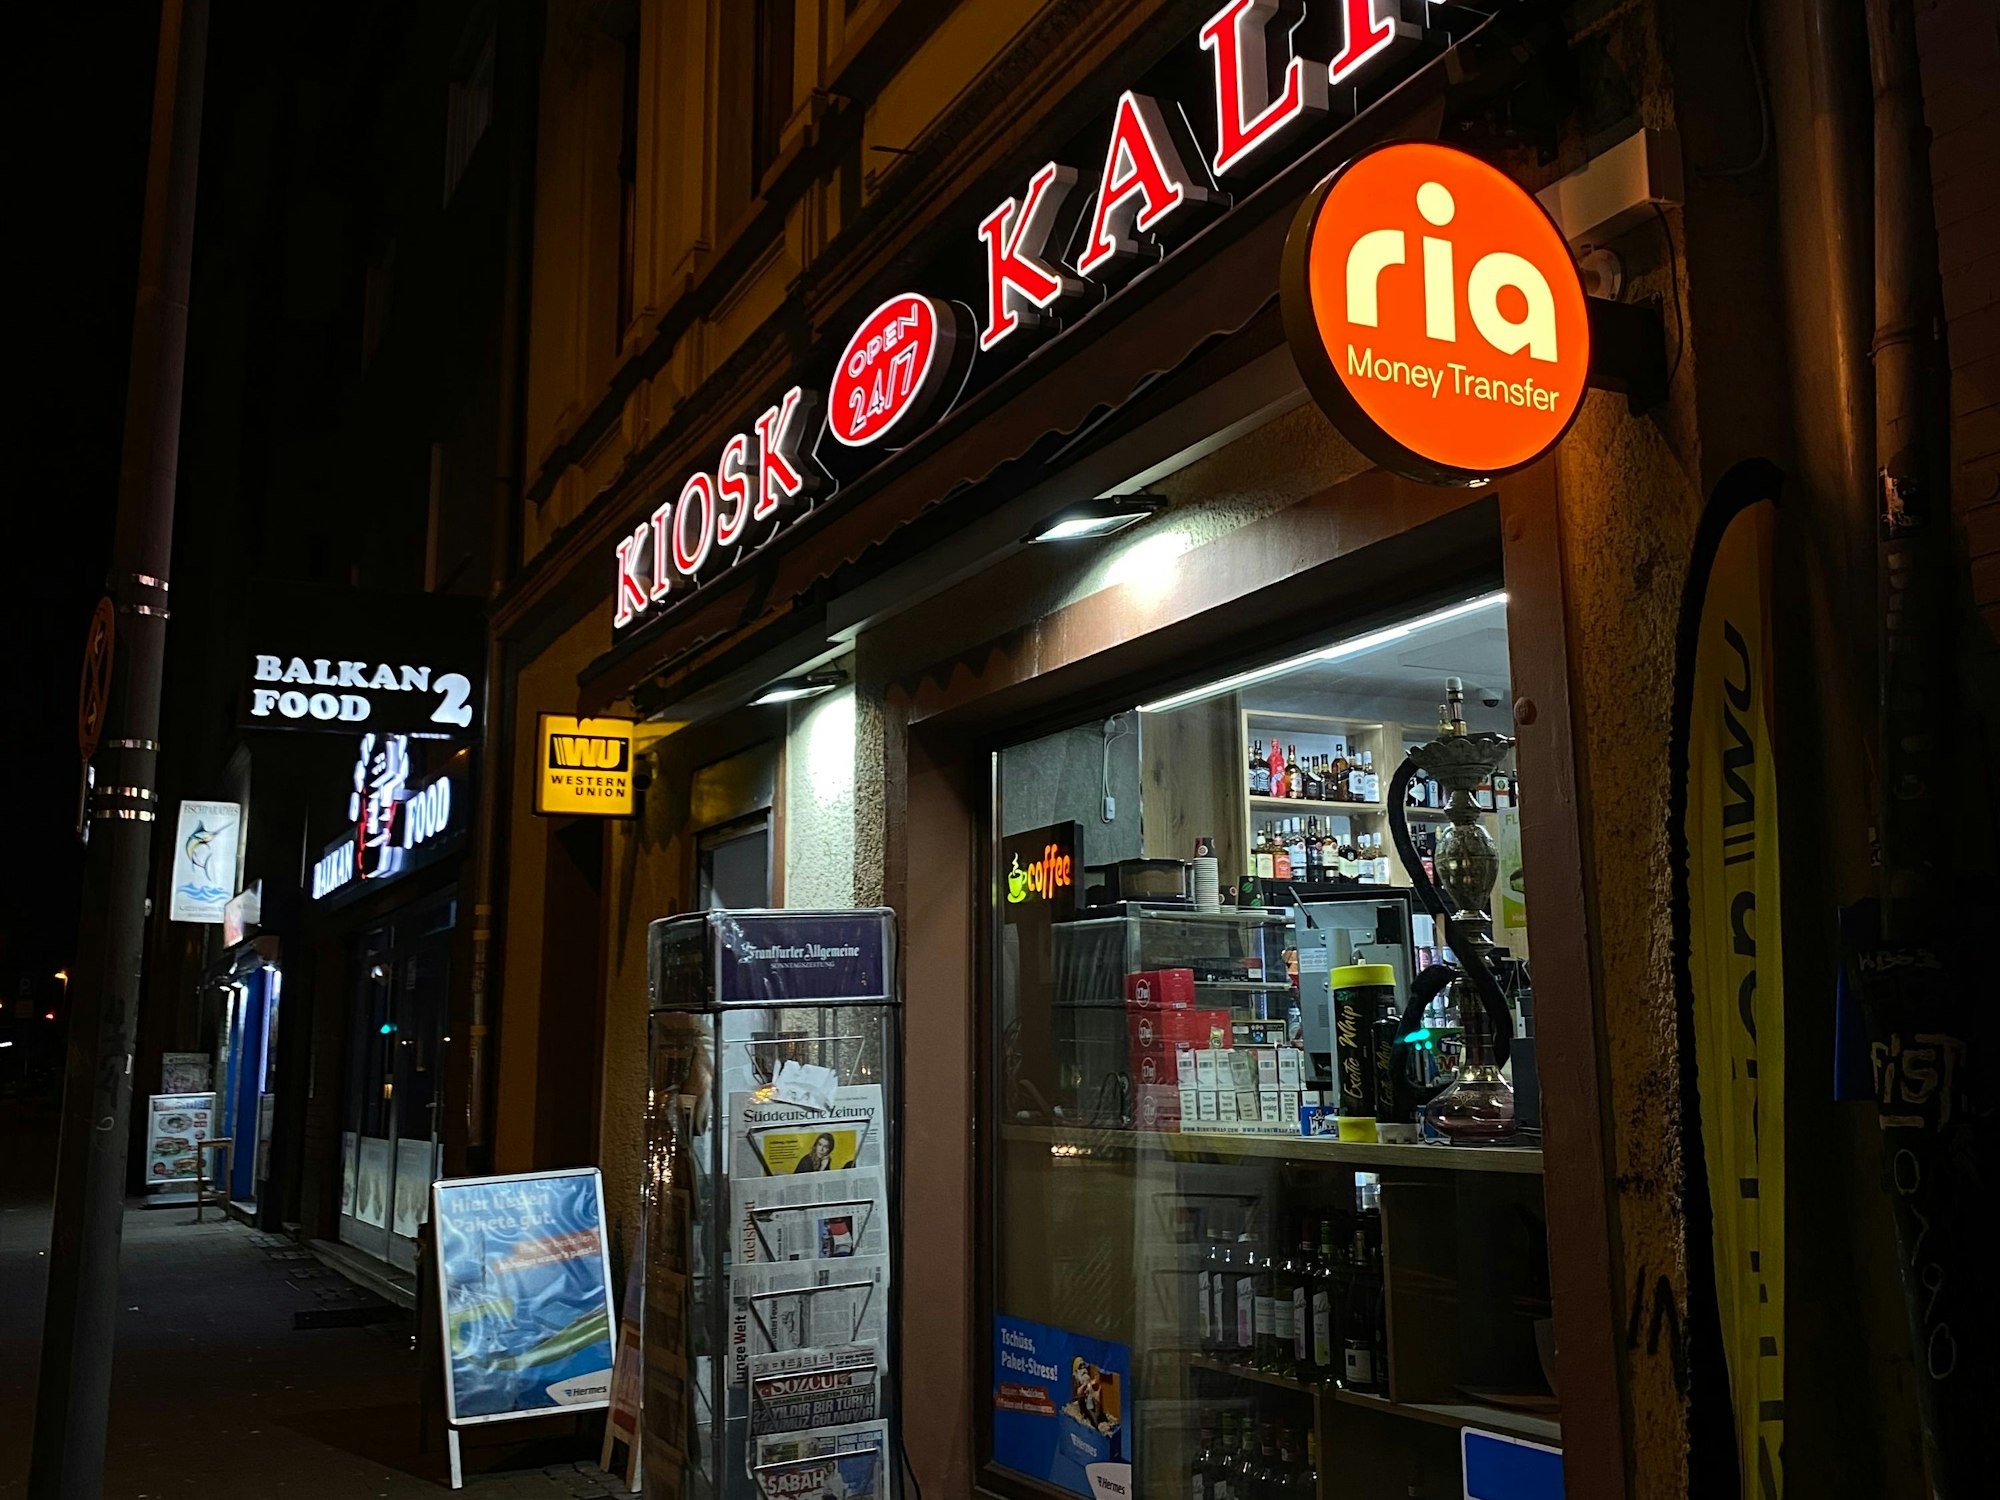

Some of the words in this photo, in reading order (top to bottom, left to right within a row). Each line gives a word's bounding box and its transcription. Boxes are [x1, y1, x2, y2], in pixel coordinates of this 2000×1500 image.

[1346, 181, 1558, 363] ria
[848, 303, 918, 378] OPEN
[848, 340, 918, 437] 24/7
[1347, 343, 1444, 399] Money
[1446, 362, 1560, 412] Transfer
[613, 385, 803, 629] KIOSK
[254, 654, 431, 692] BALKAN
[251, 688, 371, 722] FOOD
[430, 672, 473, 728] 2
[553, 736, 621, 768] WU
[551, 775, 626, 787] WESTERN
[575, 787, 625, 797] UNION
[402, 775, 450, 850] FOOD
[1027, 843, 1071, 900] coffee
[804, 943, 860, 961] Allgemeine
[1337, 1004, 1362, 1049] Whip
[1343, 1056, 1363, 1099] Exotic
[743, 1108, 827, 1123] Süddeutsche
[827, 1104, 875, 1121] Zeitung
[452, 1198, 487, 1213] Hier
[734, 1315, 747, 1346] Welt
[1001, 1327, 1036, 1355] Tschüss,
[1001, 1350, 1058, 1382] Paket-Stress!
[572, 1384, 607, 1397] Hermes
[767, 1470, 825, 1495] SABAH
[1102, 1477, 1126, 1496] Hermes
